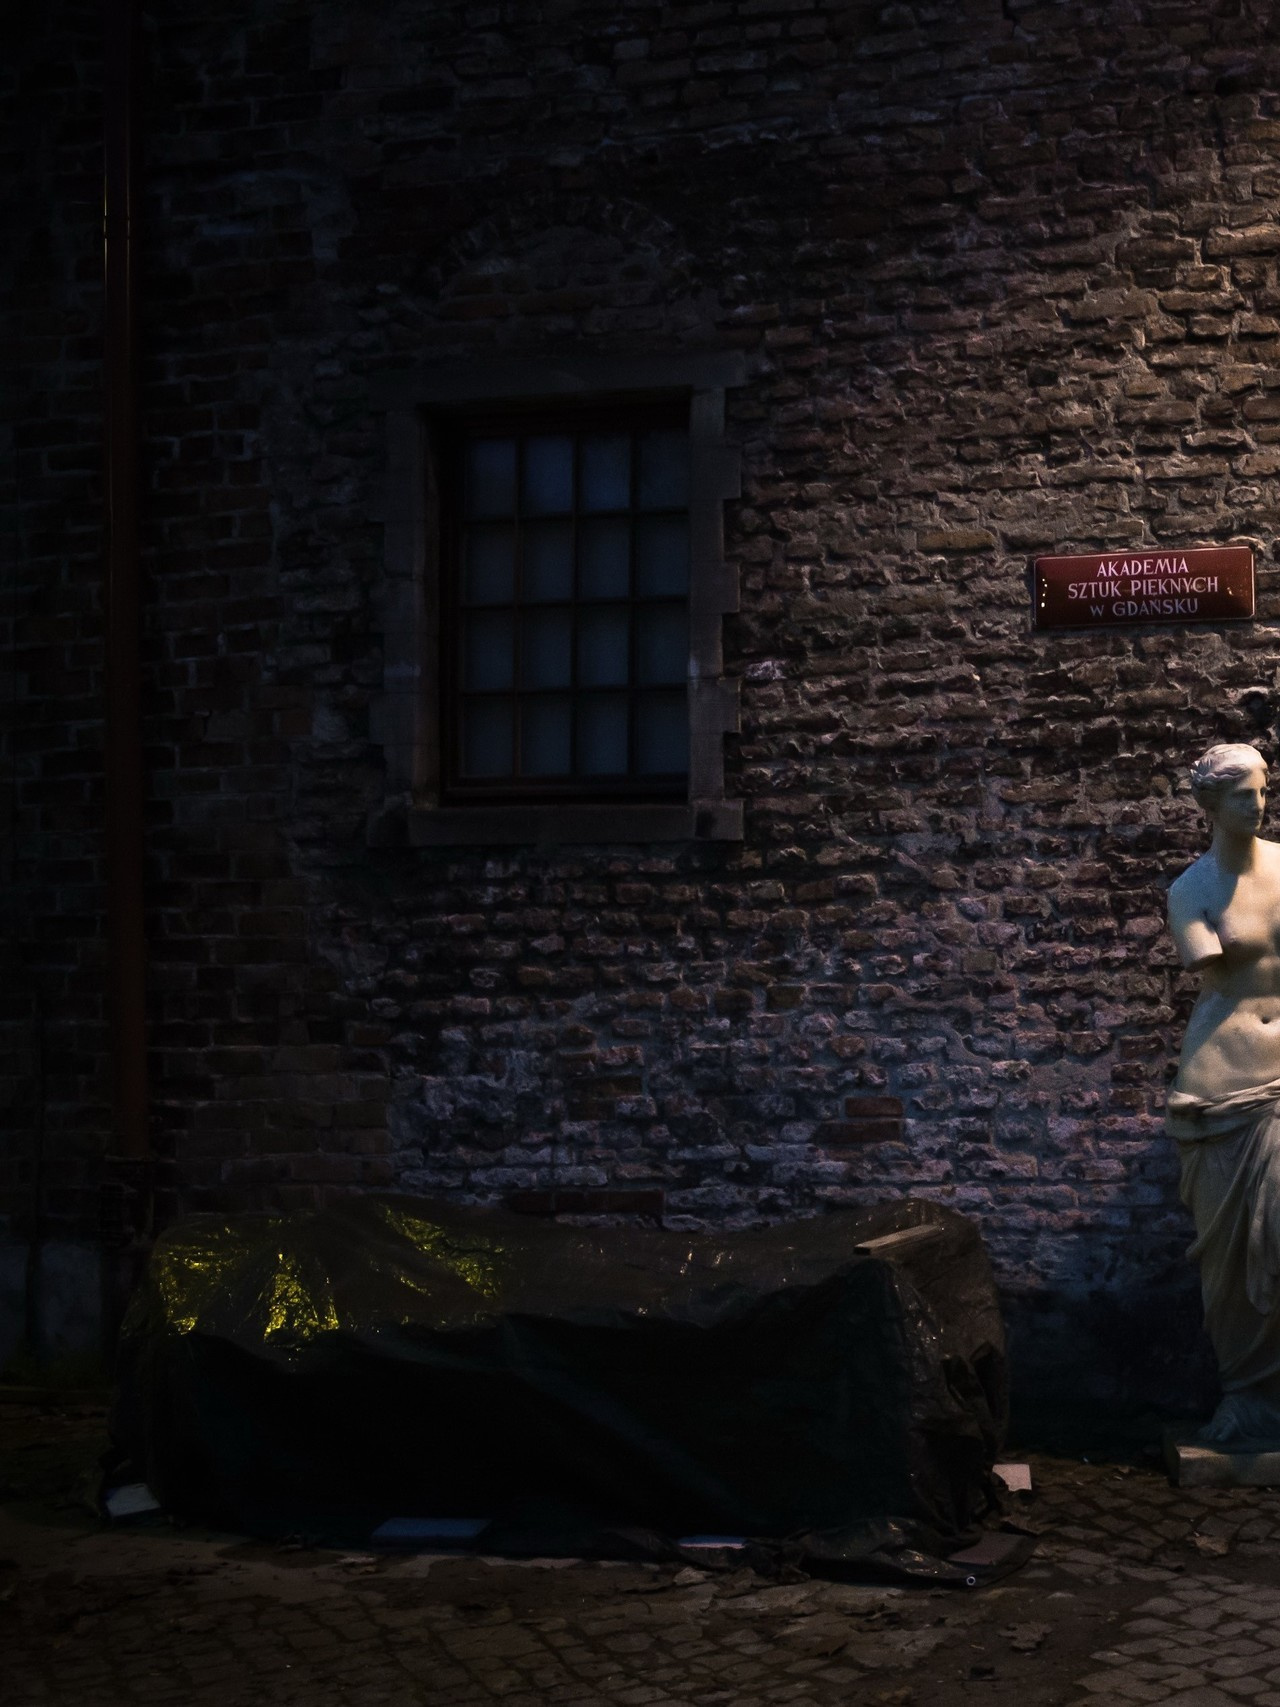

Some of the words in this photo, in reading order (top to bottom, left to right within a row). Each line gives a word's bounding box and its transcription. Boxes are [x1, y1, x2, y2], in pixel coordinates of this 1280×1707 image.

[1096, 557, 1190, 578] AKADEMIA
[1068, 580, 1122, 599] SZTUK
[1130, 576, 1219, 597] PIĘKNYCH
[1112, 597, 1199, 617] GDAŃSKU
